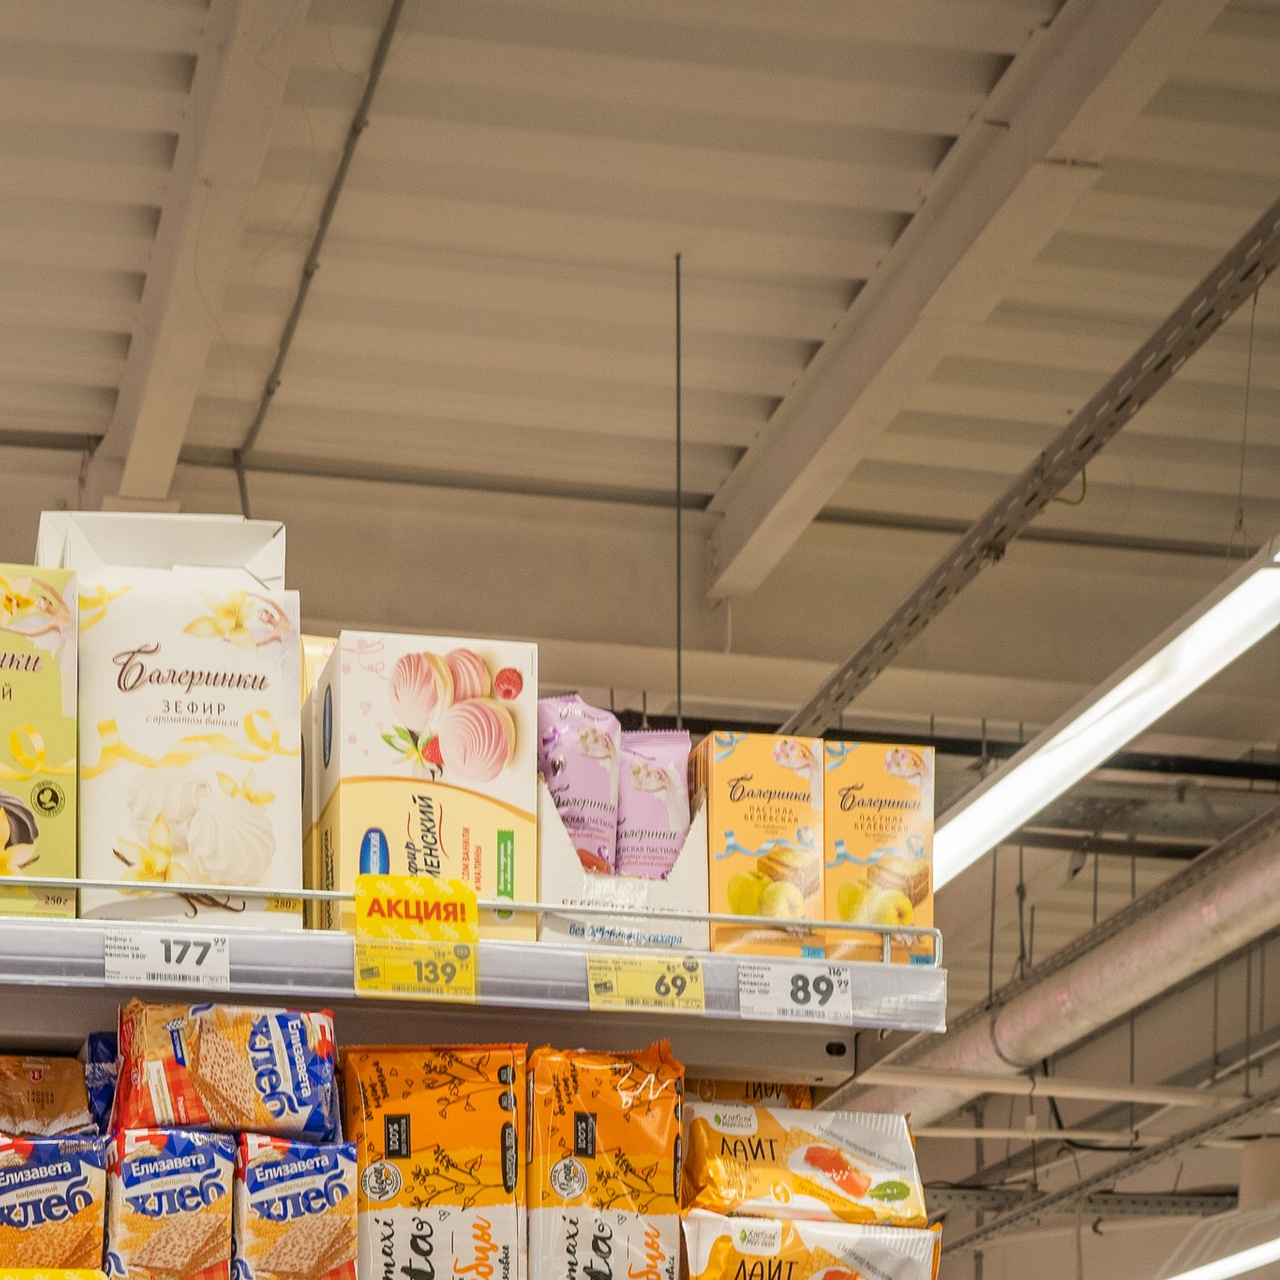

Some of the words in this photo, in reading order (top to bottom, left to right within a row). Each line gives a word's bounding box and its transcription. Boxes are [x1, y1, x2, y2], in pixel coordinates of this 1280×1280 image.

[113, 642, 268, 693] Балеринки
[162, 700, 227, 715] ЗЕФИР
[728, 775, 812, 803] Балеринки
[749, 806, 794, 815] ПАСТИЛА
[367, 898, 466, 923] АКЦИЯ!
[160, 939, 211, 966] 177
[214, 938, 227, 947] 99
[413, 959, 456, 983] 139
[655, 975, 686, 997] 69
[790, 976, 834, 1005] 89
[837, 979, 849, 988] 99
[721, 1137, 777, 1161] ЛАЙТ
[131, 1155, 205, 1176] Елизавета
[255, 1155, 329, 1181] Елизавета
[126, 1169, 226, 1220] хлеб
[151, 1176, 192, 1189] вафельный
[251, 1169, 349, 1223] хлеб
